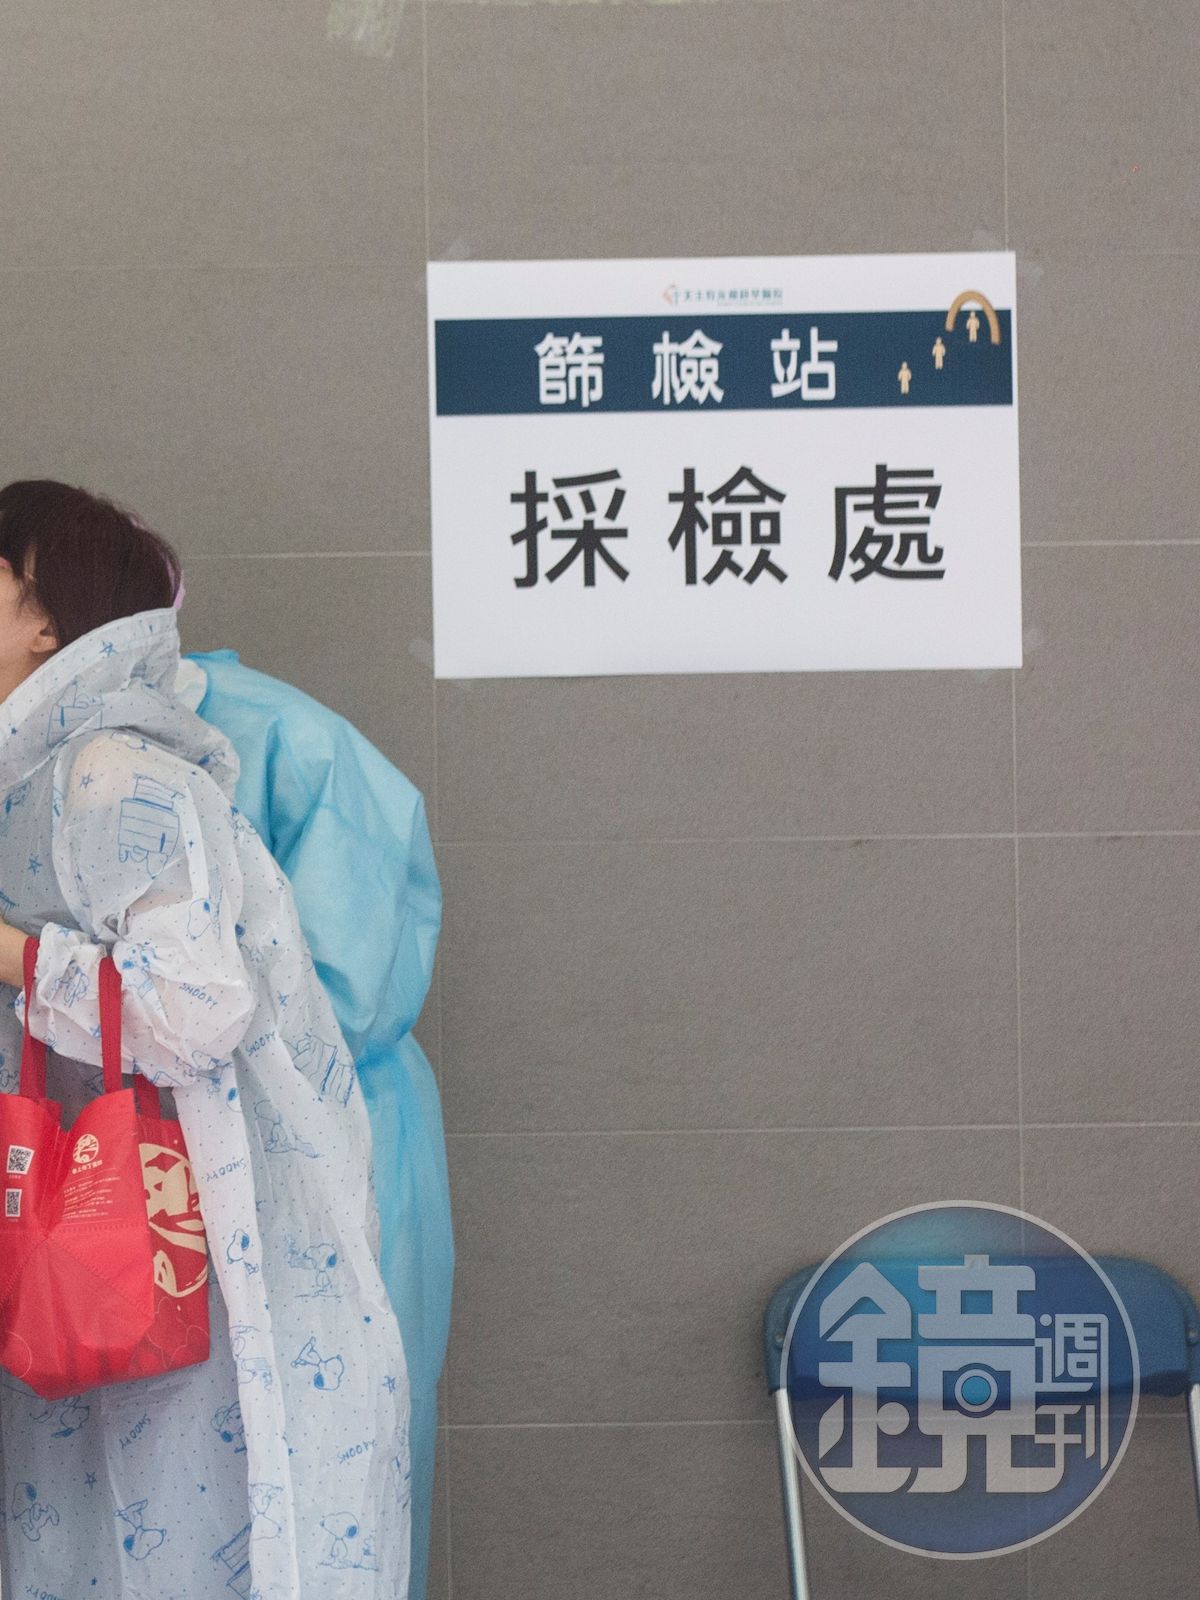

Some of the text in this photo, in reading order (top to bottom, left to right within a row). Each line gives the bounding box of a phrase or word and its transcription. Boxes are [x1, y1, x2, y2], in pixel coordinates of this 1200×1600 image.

[534, 326, 839, 407] 篩檢站
[510, 463, 947, 589] 採檢處
[179, 982, 218, 1010] SNOOPY
[245, 1031, 275, 1057] SNOOPY
[337, 1439, 376, 1464] SNOOPY
